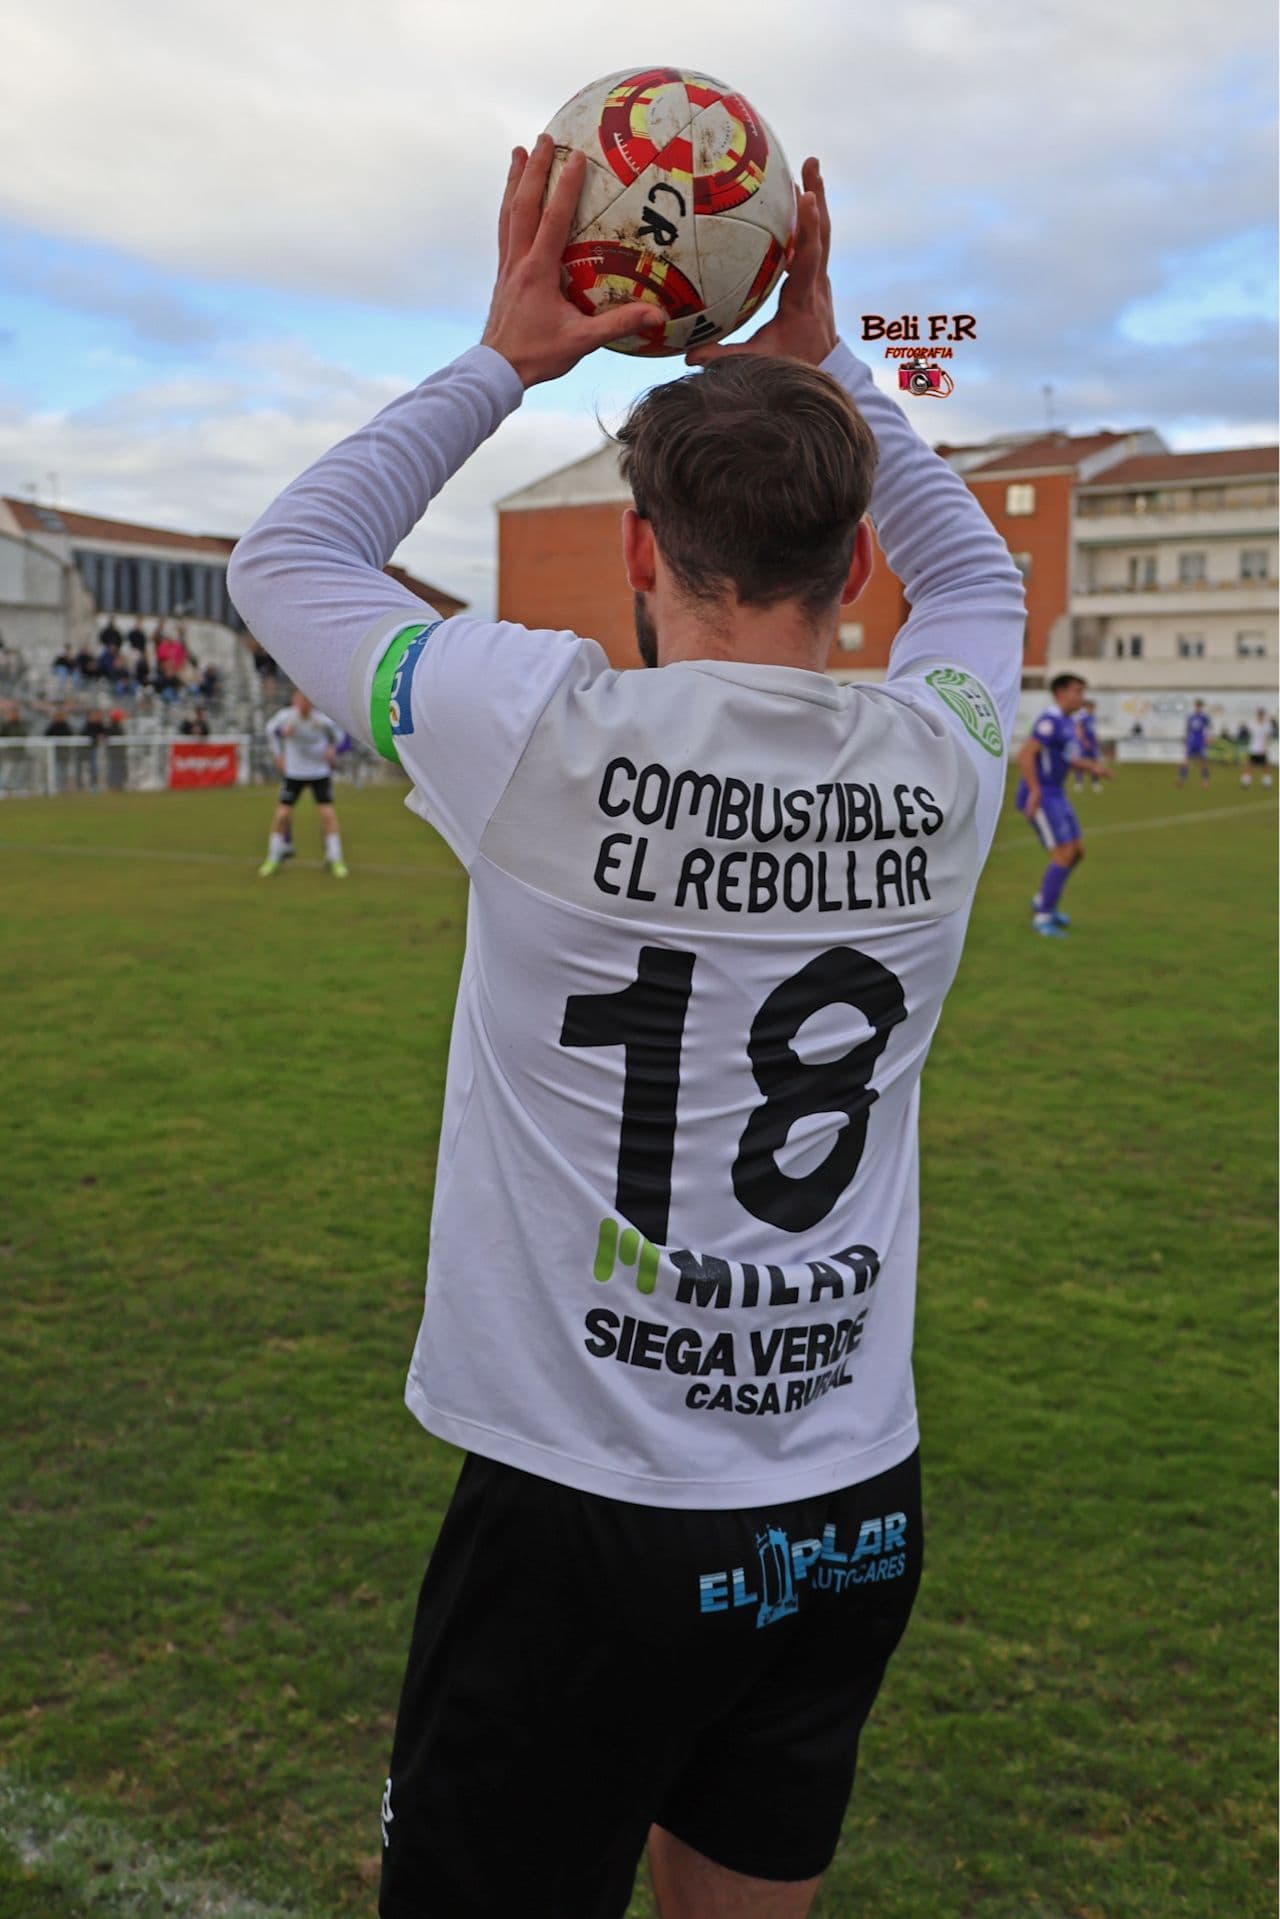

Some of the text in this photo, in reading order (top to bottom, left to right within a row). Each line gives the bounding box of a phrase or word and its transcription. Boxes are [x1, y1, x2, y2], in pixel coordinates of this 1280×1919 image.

[598, 757, 944, 843] COMBUSTIBLES
[594, 832, 931, 914] EL REBOLLAR
[559, 946, 908, 1246] 18
[669, 1244, 881, 1309] MILAR
[584, 1307, 869, 1377] SIEGA VERDE
[685, 1383, 780, 1416] CASA
[700, 1567, 758, 1613] EL
[812, 1552, 906, 1593] UTARES
